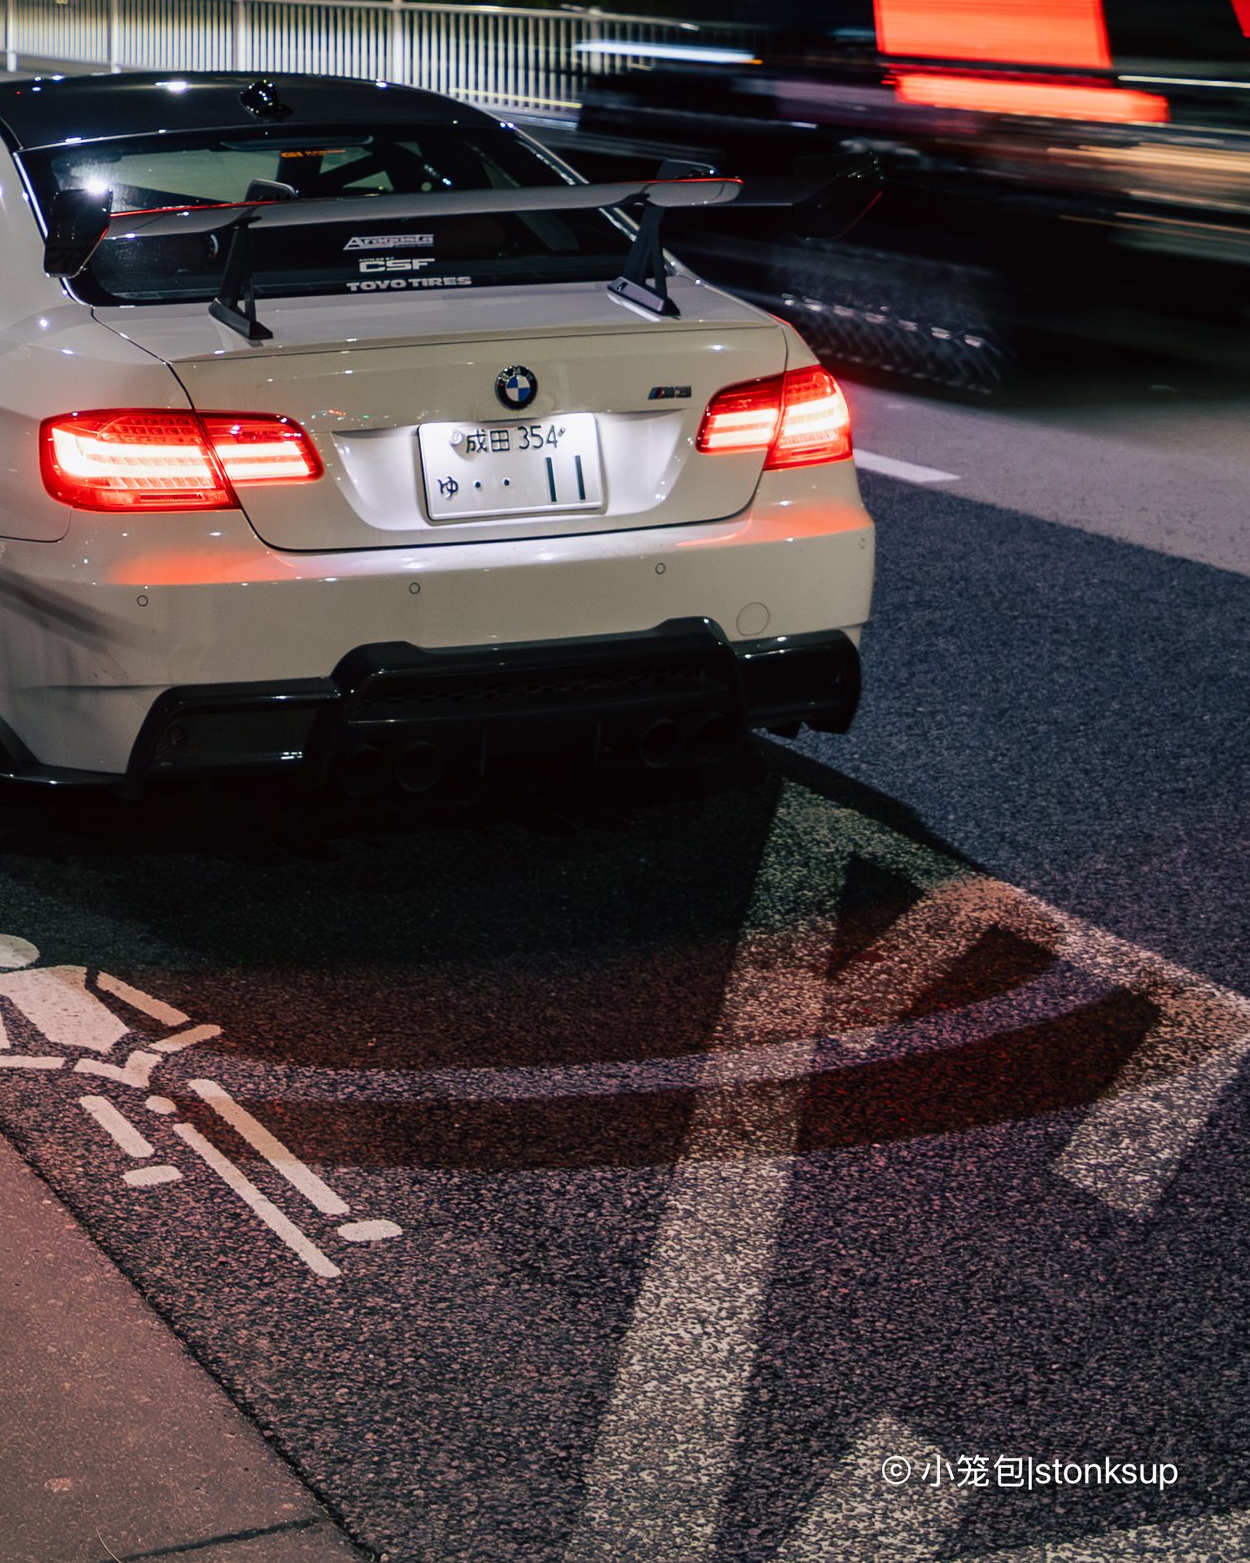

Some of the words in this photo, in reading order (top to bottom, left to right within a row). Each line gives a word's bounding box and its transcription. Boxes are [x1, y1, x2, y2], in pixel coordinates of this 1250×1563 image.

[359, 258, 435, 273] CSF
[346, 279, 406, 291] TOYO
[408, 276, 472, 288] TIRES
[466, 429, 511, 454] 成田
[518, 424, 558, 450] 354
[437, 475, 459, 501] ゆ
